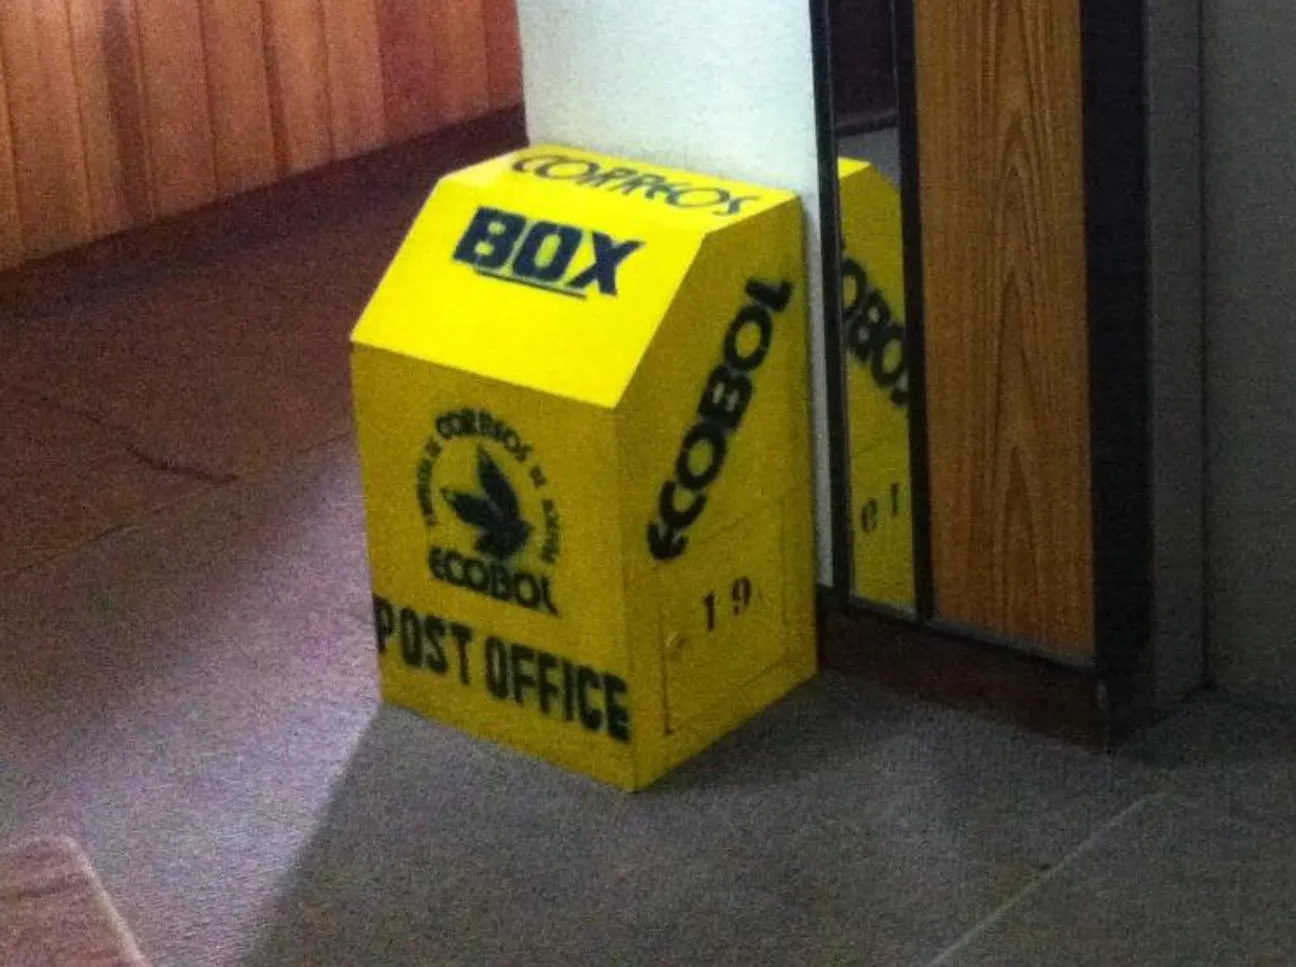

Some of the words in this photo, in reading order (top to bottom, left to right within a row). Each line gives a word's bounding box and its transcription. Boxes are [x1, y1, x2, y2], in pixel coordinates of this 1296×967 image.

[453, 204, 645, 296] BOX
[646, 277, 794, 561] ECOBOL
[428, 545, 560, 617] ECOBOL
[372, 592, 475, 685] POST
[484, 634, 632, 744] OFFICE
